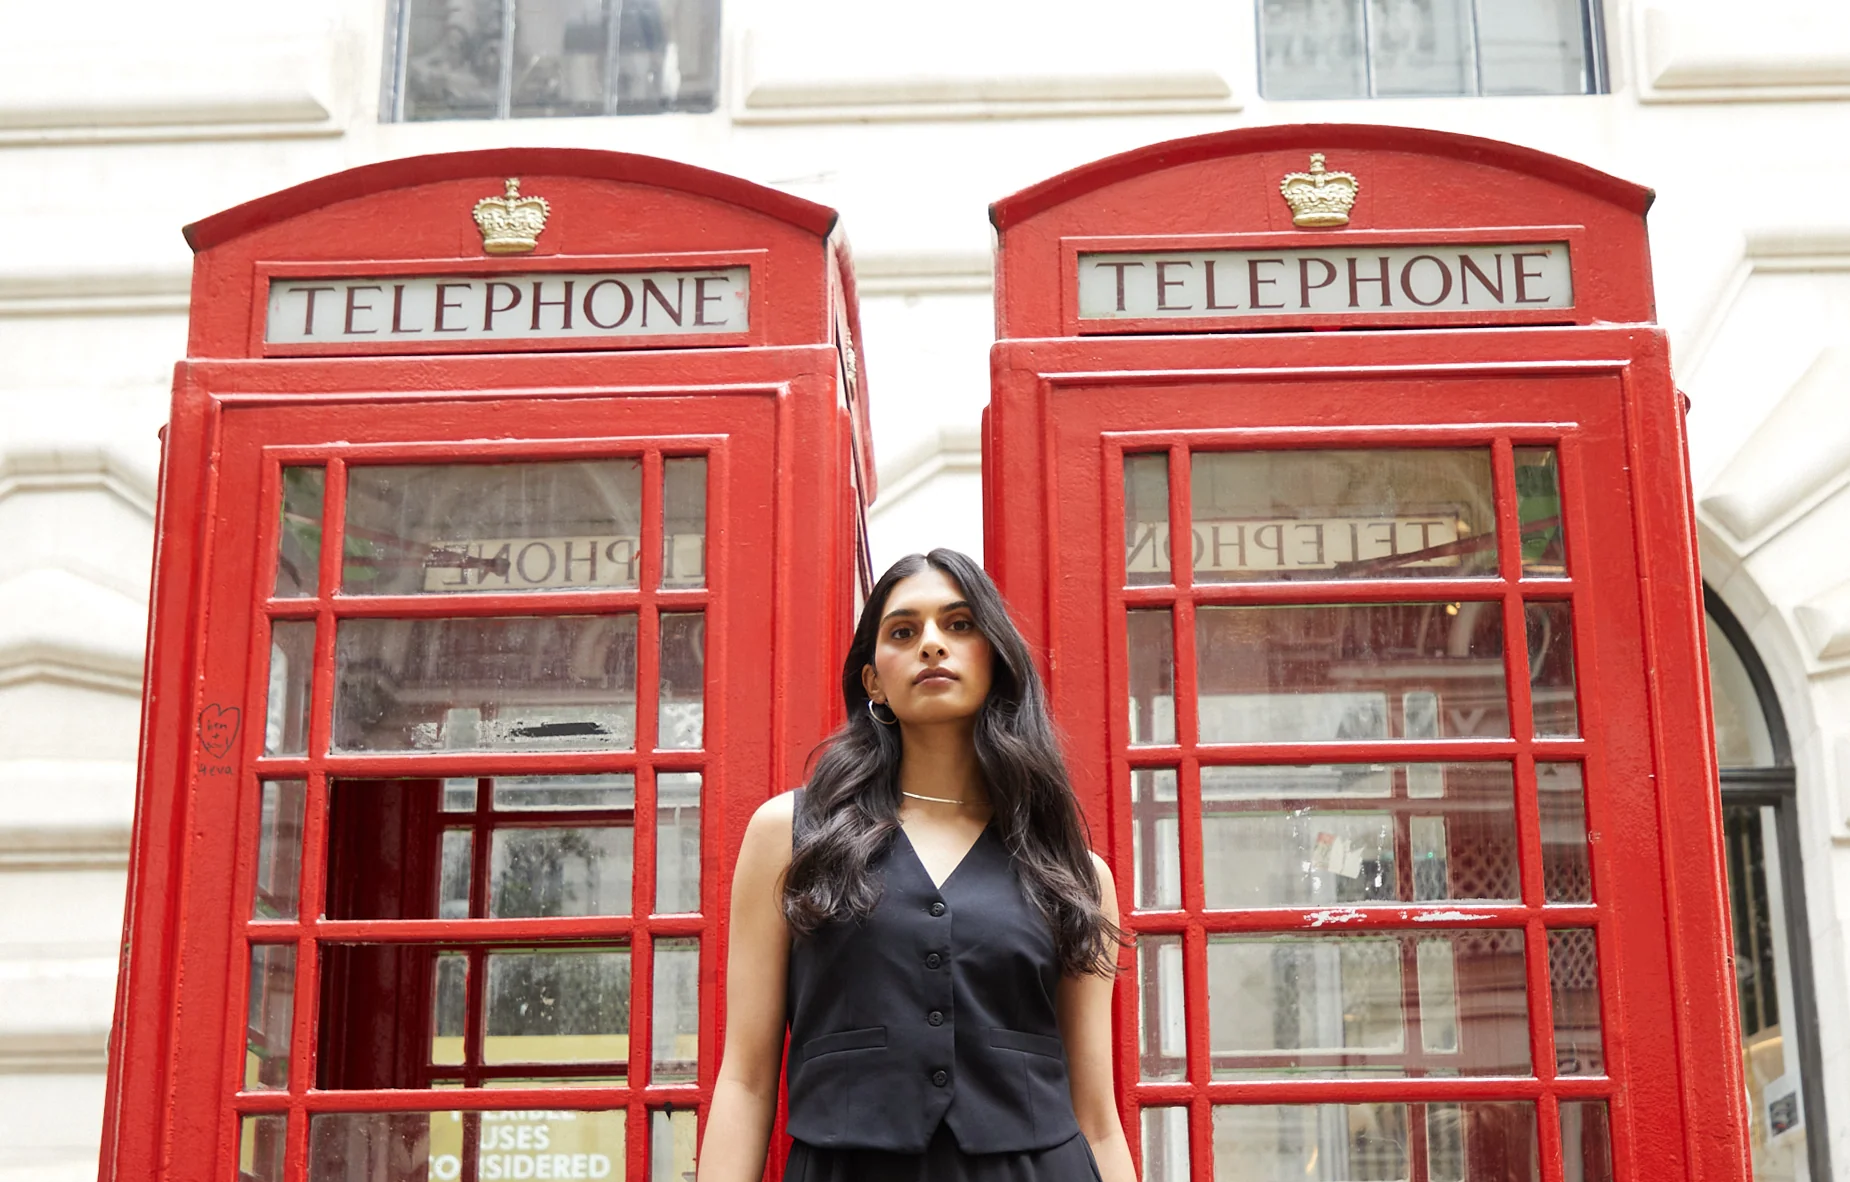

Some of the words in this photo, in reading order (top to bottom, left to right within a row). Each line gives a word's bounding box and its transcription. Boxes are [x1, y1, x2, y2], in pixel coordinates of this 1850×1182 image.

[1095, 252, 1552, 313] TELEPHONE
[287, 276, 731, 336] TELEPHONE
[479, 1124, 550, 1150] USES
[428, 1153, 611, 1180] OSIDERED
